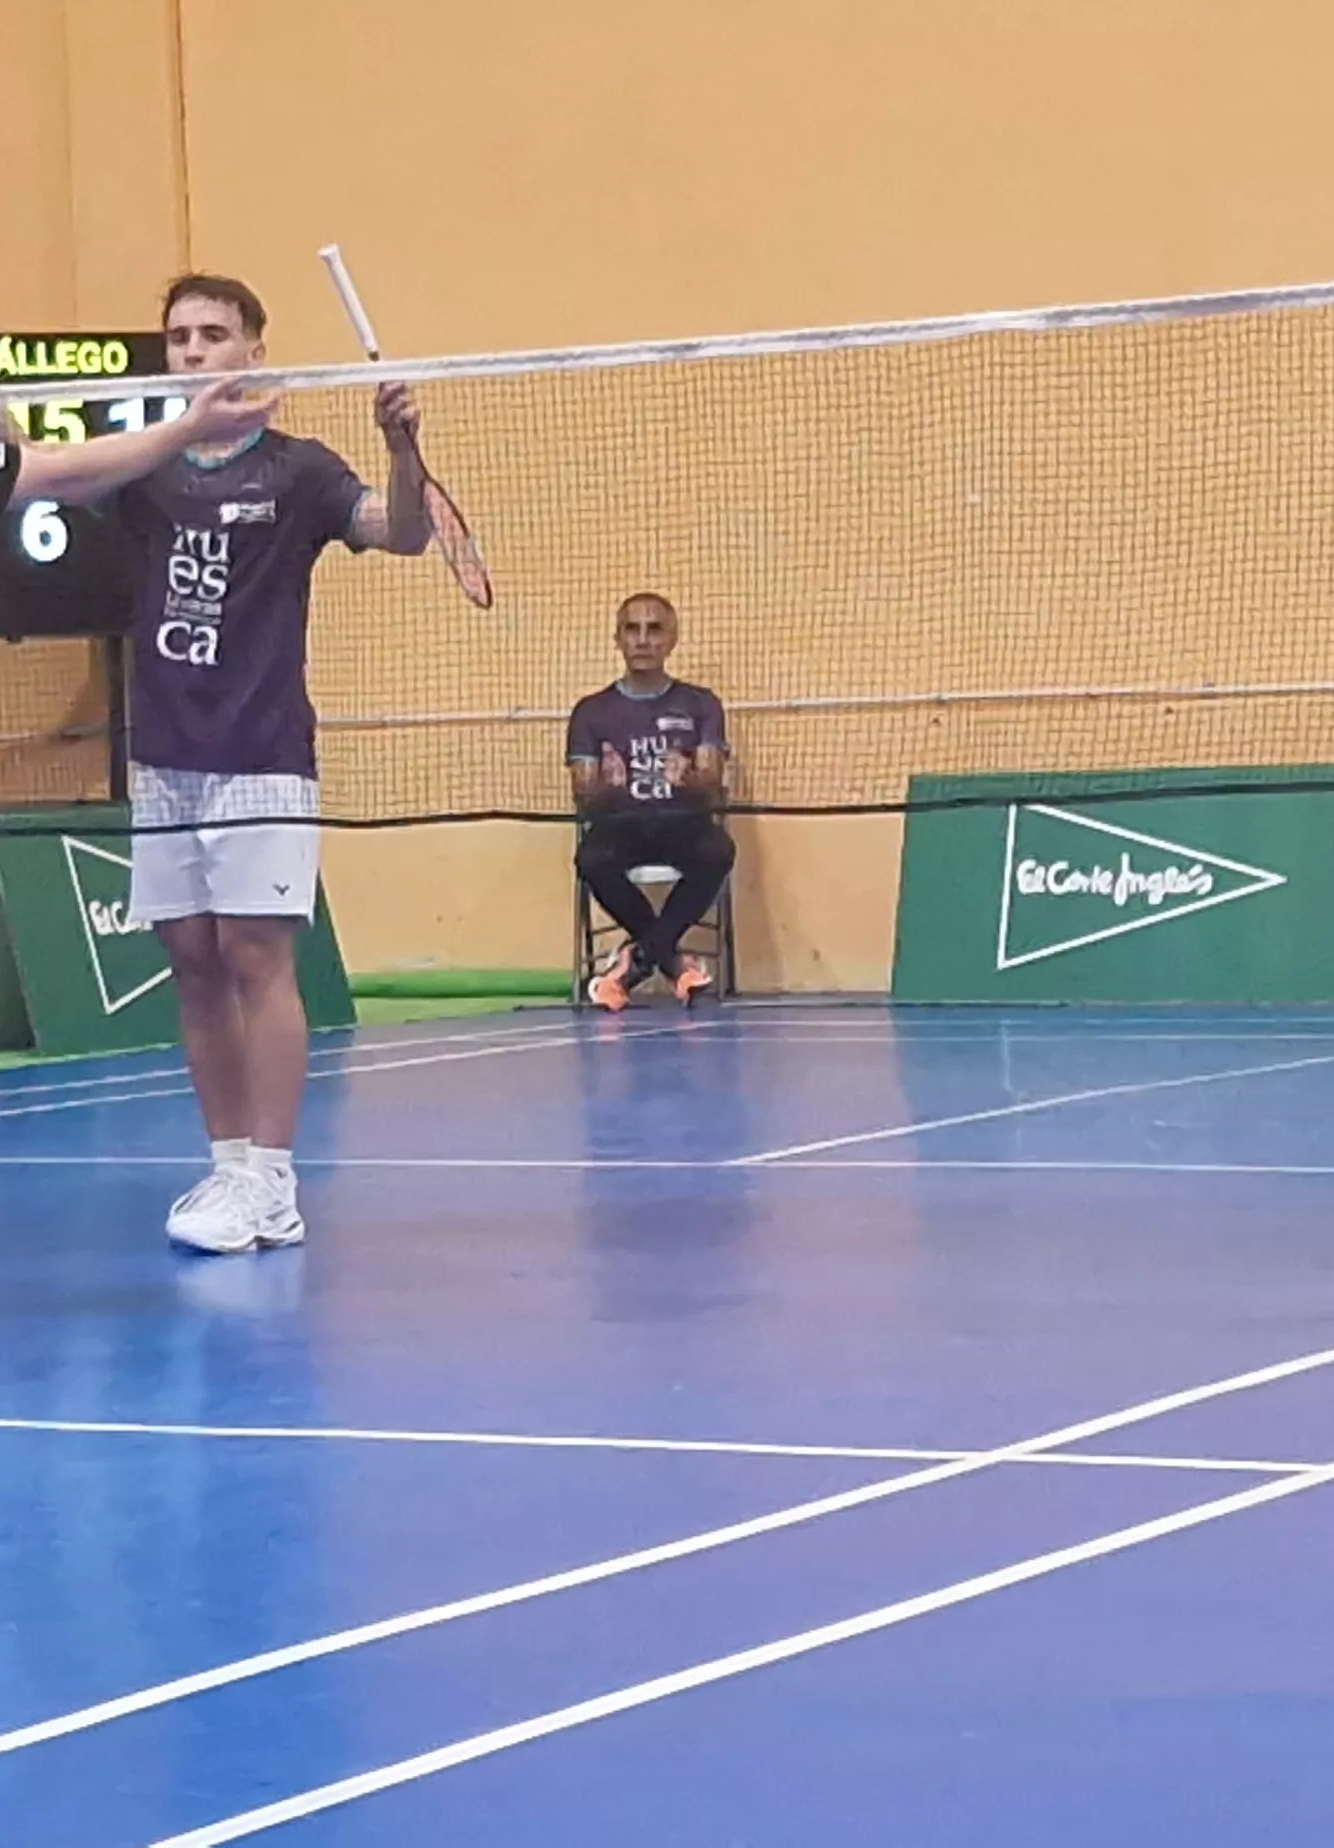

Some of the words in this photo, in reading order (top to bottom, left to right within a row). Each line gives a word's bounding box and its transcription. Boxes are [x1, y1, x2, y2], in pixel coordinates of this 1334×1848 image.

[21, 500, 68, 562] 6
[157, 620, 218, 665] ca
[1017, 859, 1045, 894] El
[1047, 860, 1113, 895] Corte
[1113, 852, 1213, 906] Inglés
